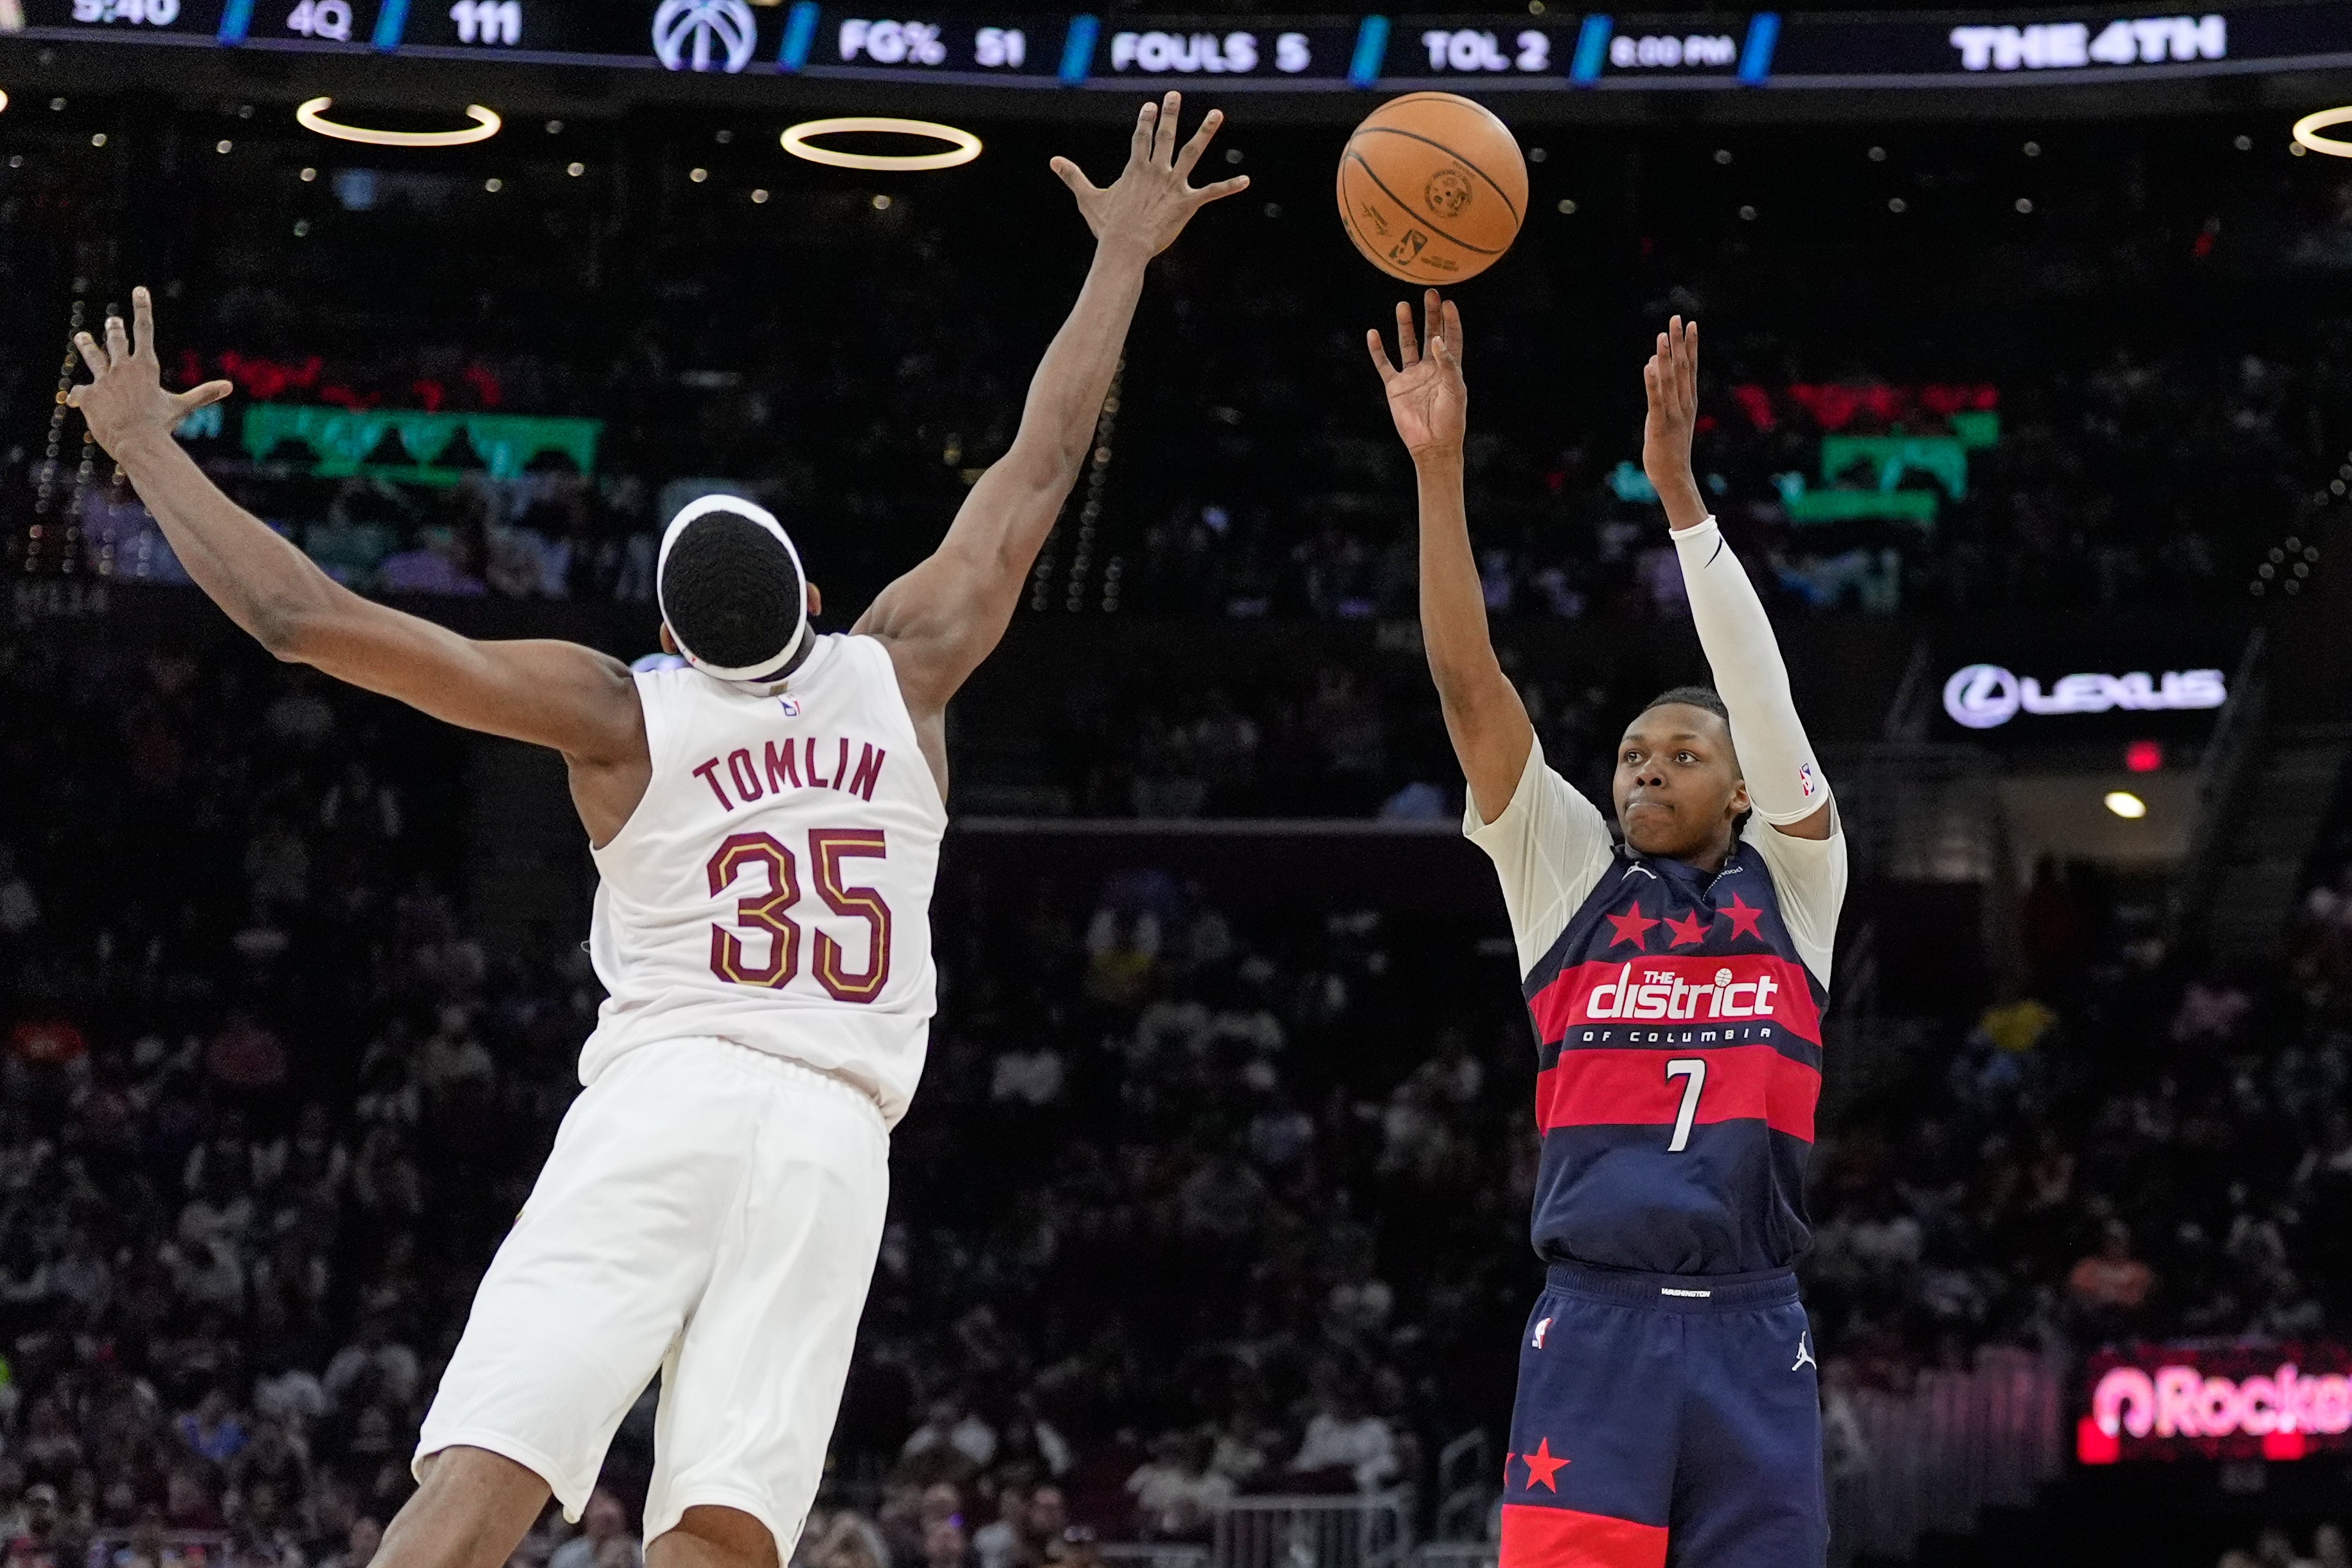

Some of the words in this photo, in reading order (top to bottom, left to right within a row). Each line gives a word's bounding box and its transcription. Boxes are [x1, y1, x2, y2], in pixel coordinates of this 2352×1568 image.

[286, 0, 352, 42] 4Q
[450, 0, 522, 45] 111
[838, 19, 947, 65] FG%
[974, 27, 1026, 67] 51
[1949, 22, 2089, 71] THE
[2088, 14, 2228, 64] 4TH
[1111, 31, 1258, 73] FOULS
[1275, 33, 1311, 73] 5
[1423, 30, 1510, 71] TOL
[1516, 30, 1551, 72] 2
[1683, 35, 1736, 66] PM
[2020, 669, 2227, 715] LEXUS
[692, 737, 886, 812] TOMLIN
[706, 828, 892, 1004] 35
[1585, 961, 1779, 1020] district
[1643, 970, 1676, 985] THE
[1582, 1031, 1612, 1042] OF
[1629, 1028, 1772, 1043] COLUMBIA
[1666, 1058, 1707, 1152] 7
[1661, 1287, 1711, 1297] WASHINGTON
[2154, 1364, 2352, 1437] Rocke
